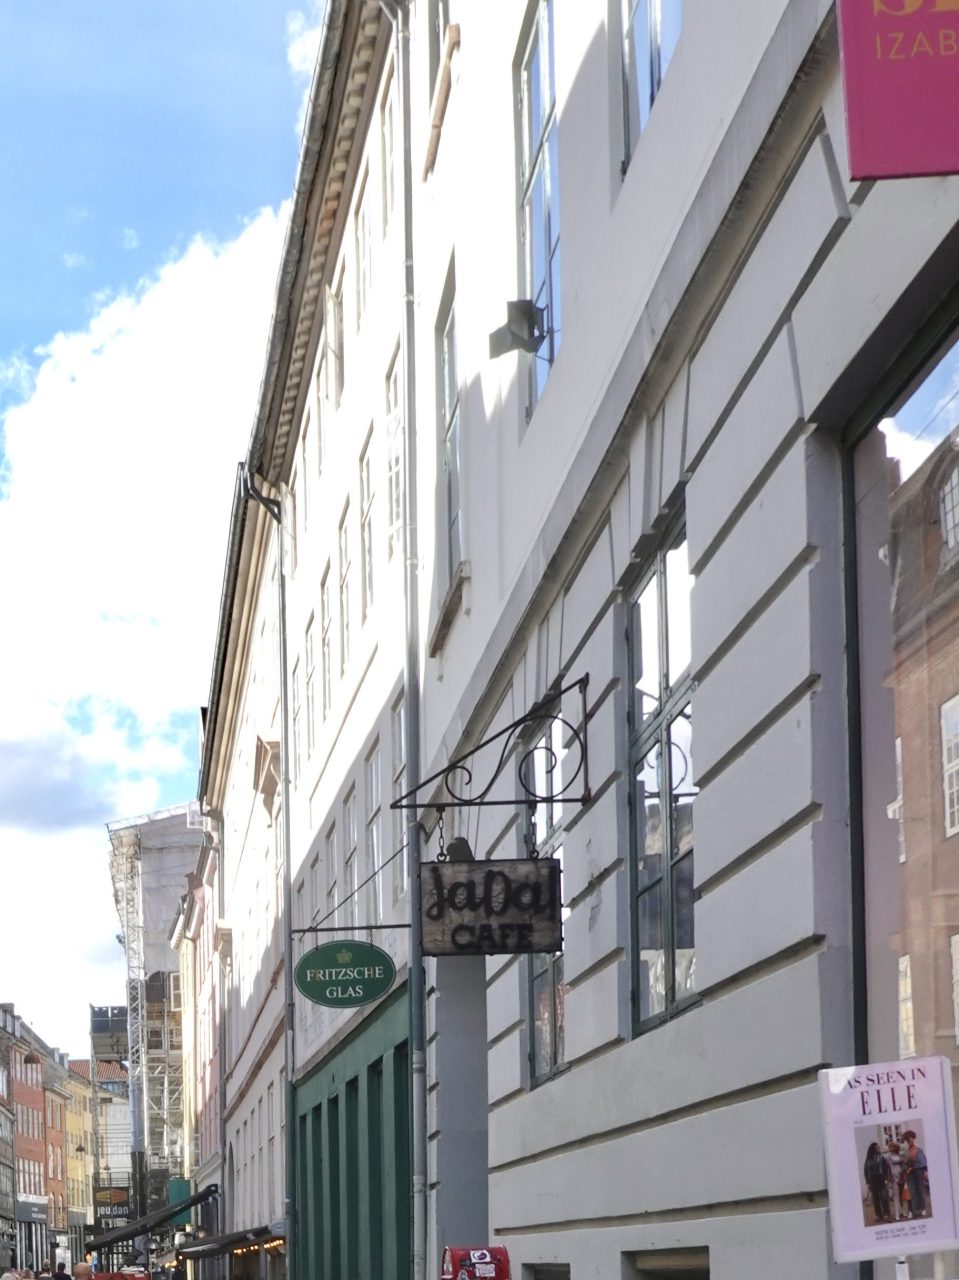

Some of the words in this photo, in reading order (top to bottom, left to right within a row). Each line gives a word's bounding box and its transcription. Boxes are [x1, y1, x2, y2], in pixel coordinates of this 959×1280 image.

[451, 922, 533, 950] CAFE
[306, 966, 385, 981] FRITZSCHE
[325, 985, 364, 998] GLAS
[866, 1070, 906, 1087] SEEN
[911, 1067, 927, 1079] IN
[860, 1084, 918, 1116] ELLE
